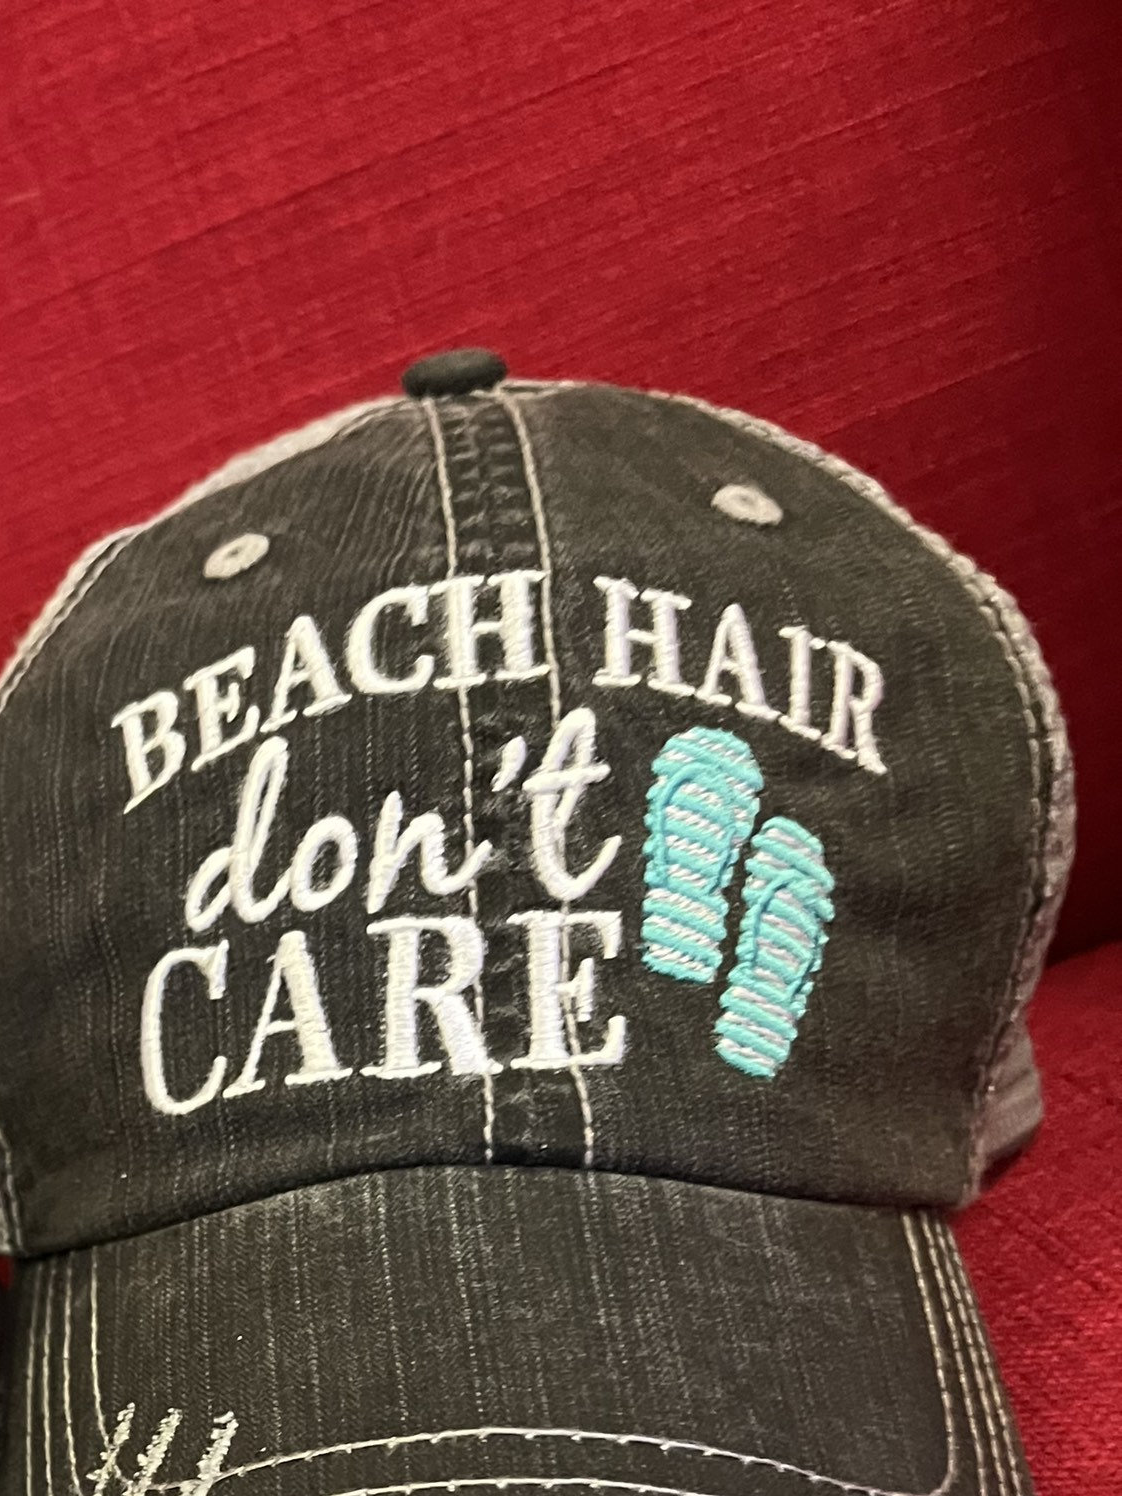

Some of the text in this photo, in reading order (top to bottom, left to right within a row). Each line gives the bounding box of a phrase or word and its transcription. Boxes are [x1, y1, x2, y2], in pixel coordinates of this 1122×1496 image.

[111, 569, 888, 813] BEACH HAIR
[184, 706, 622, 933] don't
[140, 908, 627, 1117] CARE
